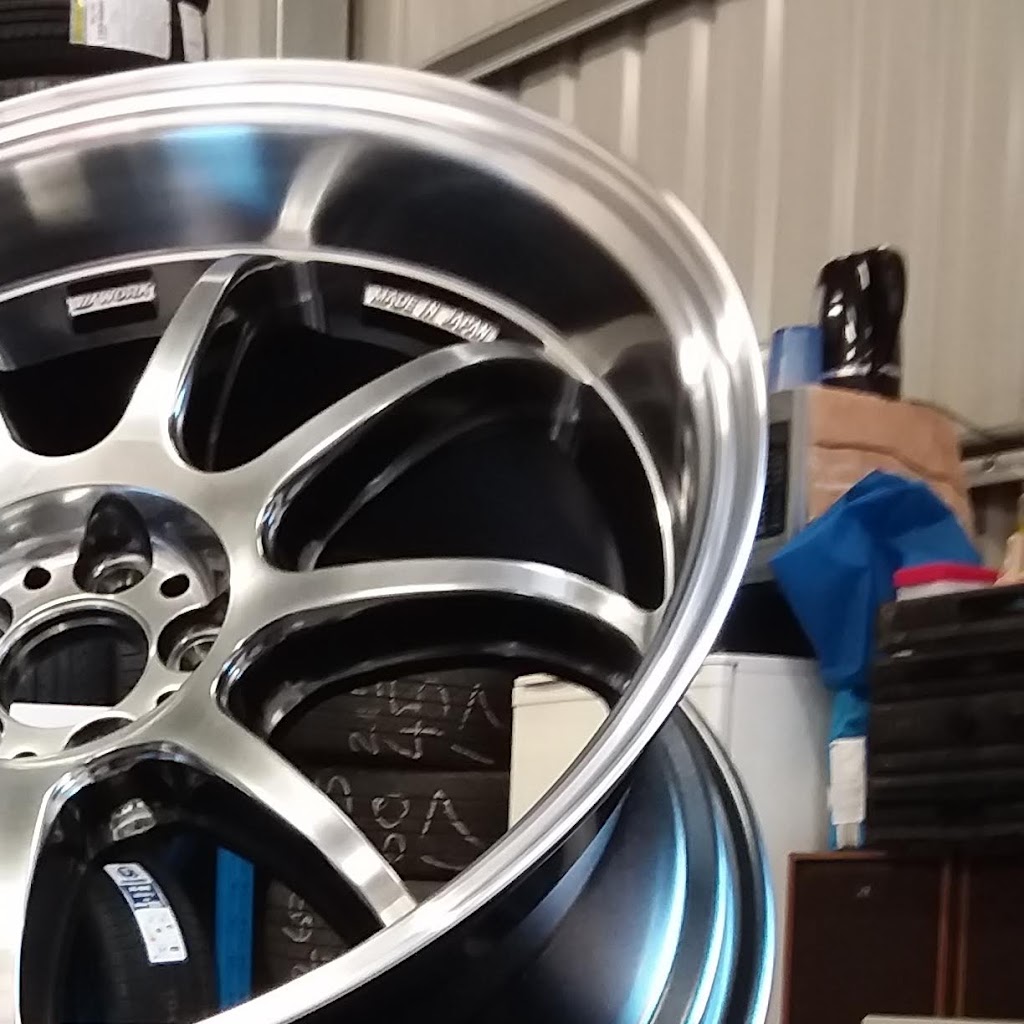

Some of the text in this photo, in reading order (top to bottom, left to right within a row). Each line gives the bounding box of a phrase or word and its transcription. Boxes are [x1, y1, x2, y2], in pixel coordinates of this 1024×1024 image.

[370, 286, 497, 342] MADE IN JAPAN
